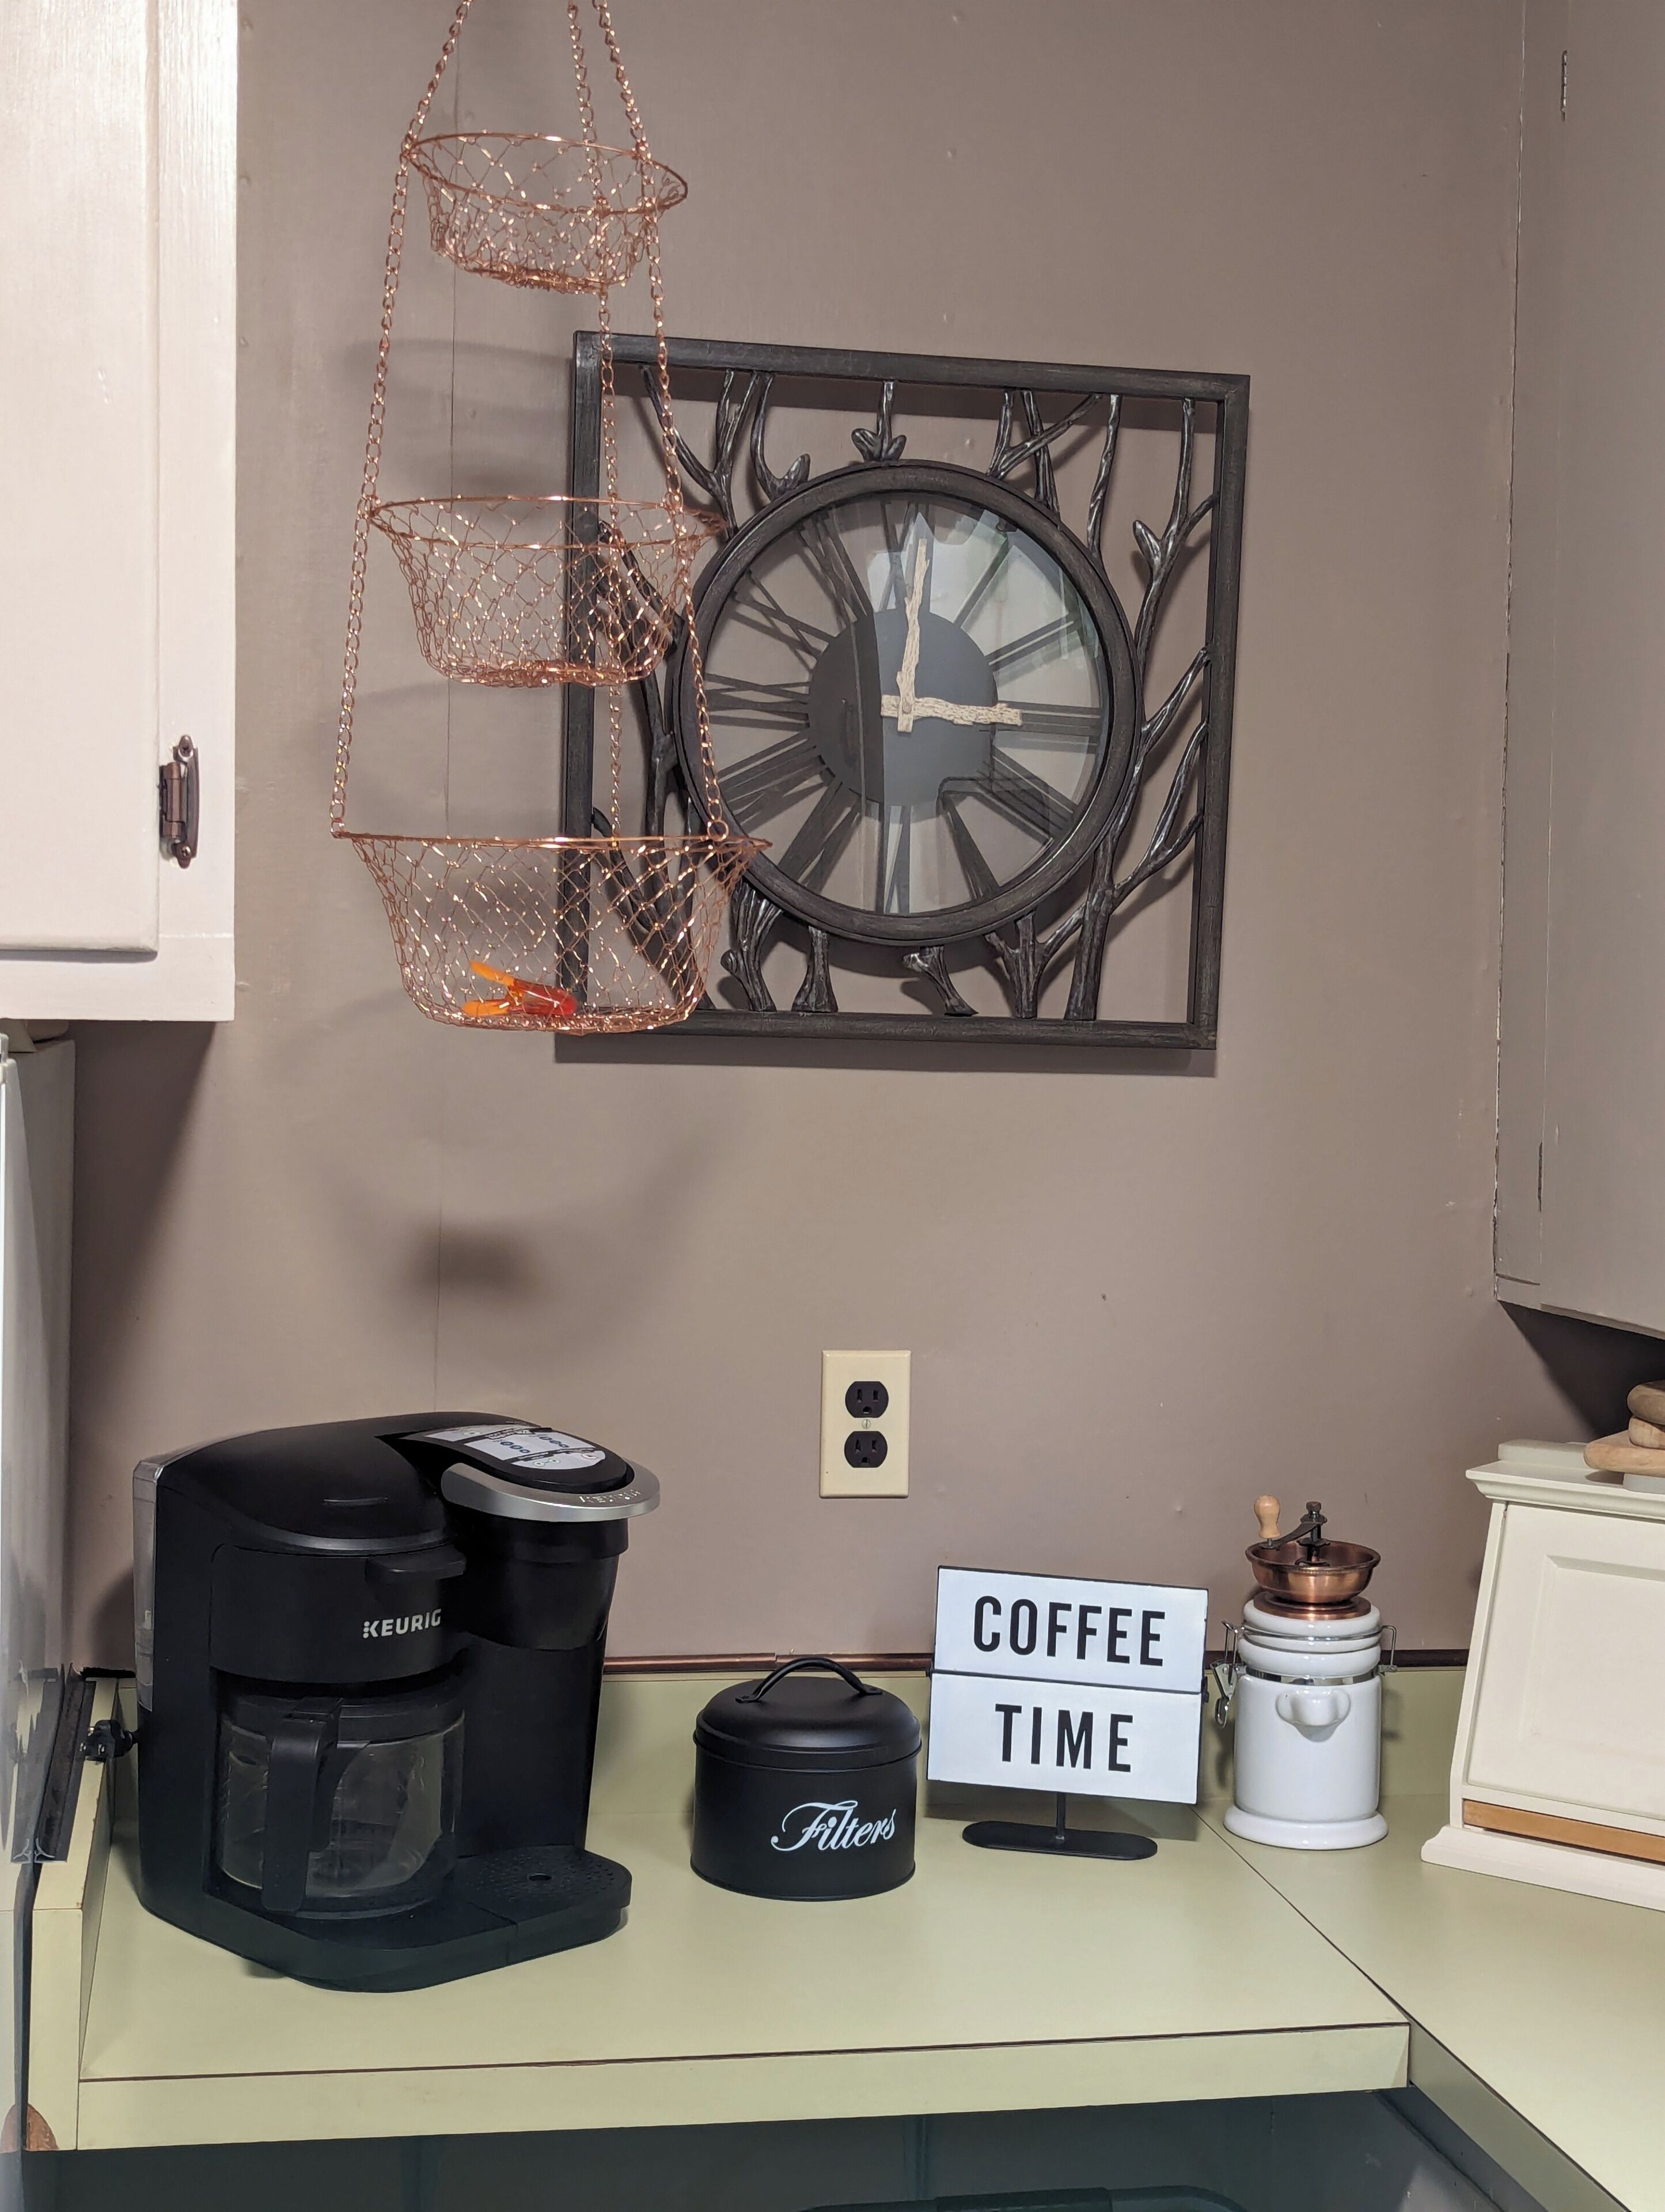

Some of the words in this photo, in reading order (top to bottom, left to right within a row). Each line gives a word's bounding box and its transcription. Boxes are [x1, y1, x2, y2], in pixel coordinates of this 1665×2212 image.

[363, 1608, 442, 1639] KEURIG
[974, 1596, 1165, 1666] COFFEE
[995, 1704, 1132, 1772] TIME
[771, 1800, 897, 1851] Filters
